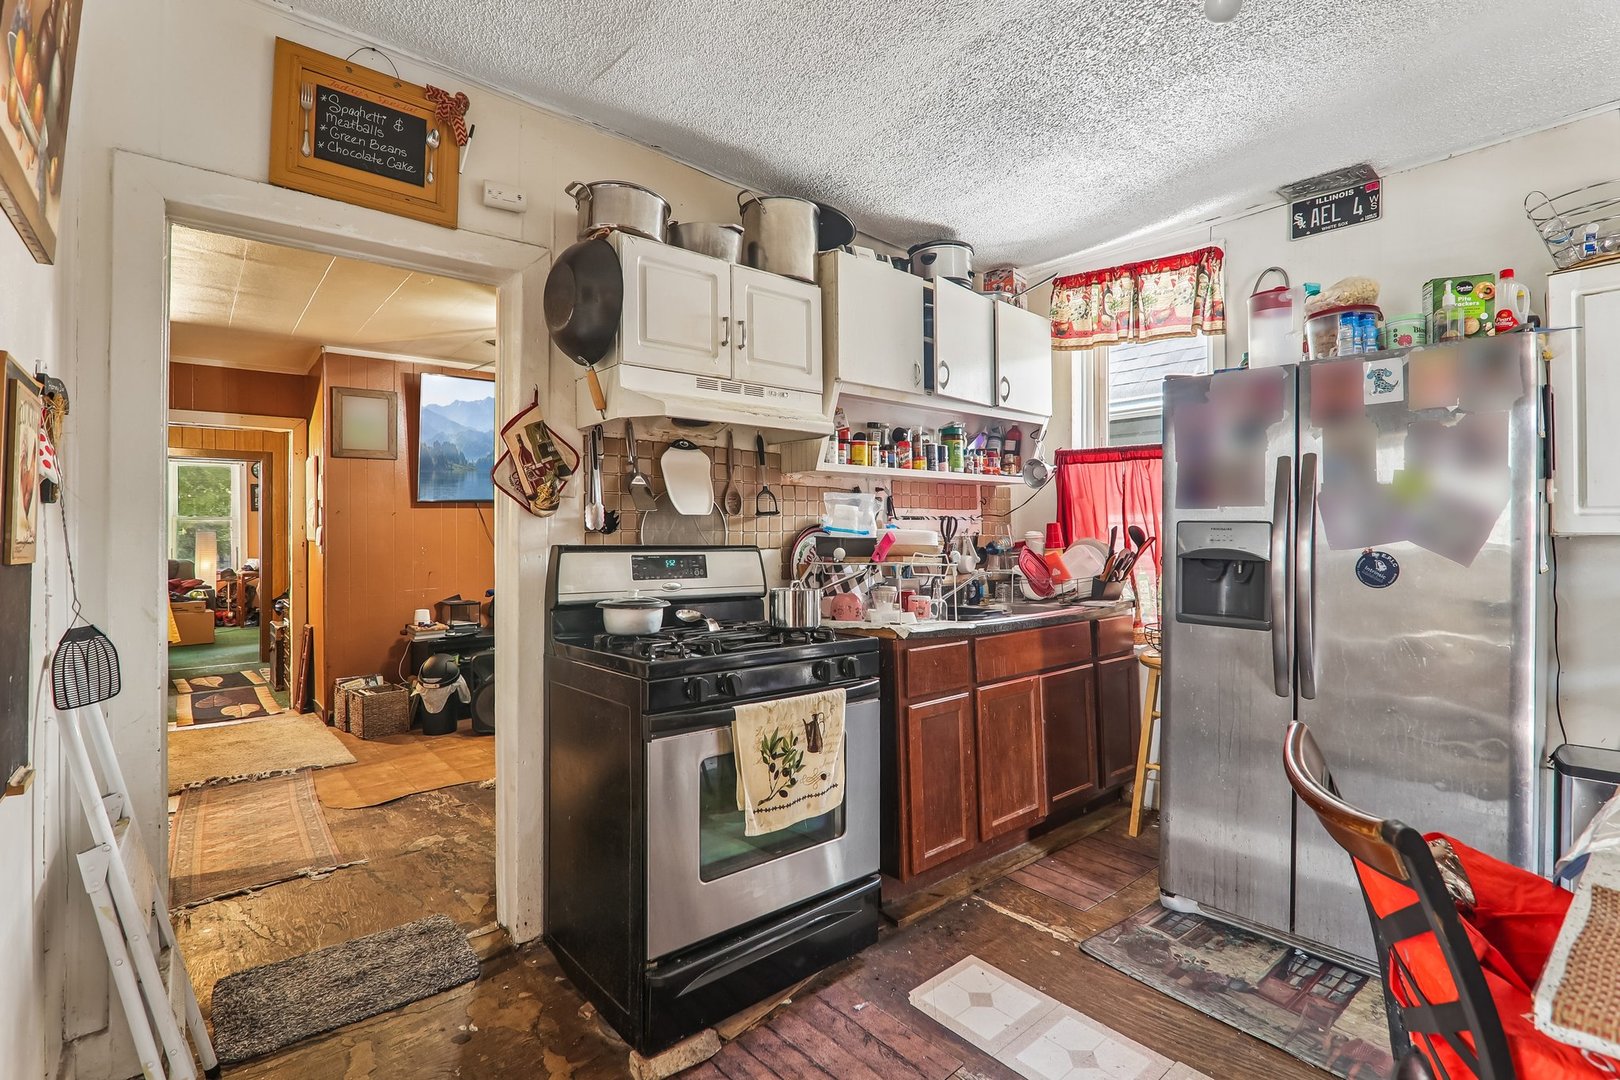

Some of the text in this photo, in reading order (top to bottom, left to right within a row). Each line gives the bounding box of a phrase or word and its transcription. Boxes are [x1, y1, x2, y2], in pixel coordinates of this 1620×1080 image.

[328, 94, 404, 132] Spaghetti &
[327, 141, 417, 174] Chocolate Cake
[329, 126, 408, 158] Green Beans
[1310, 196, 1364, 228] AEL 4
[1315, 189, 1355, 205] ILLINOIS
